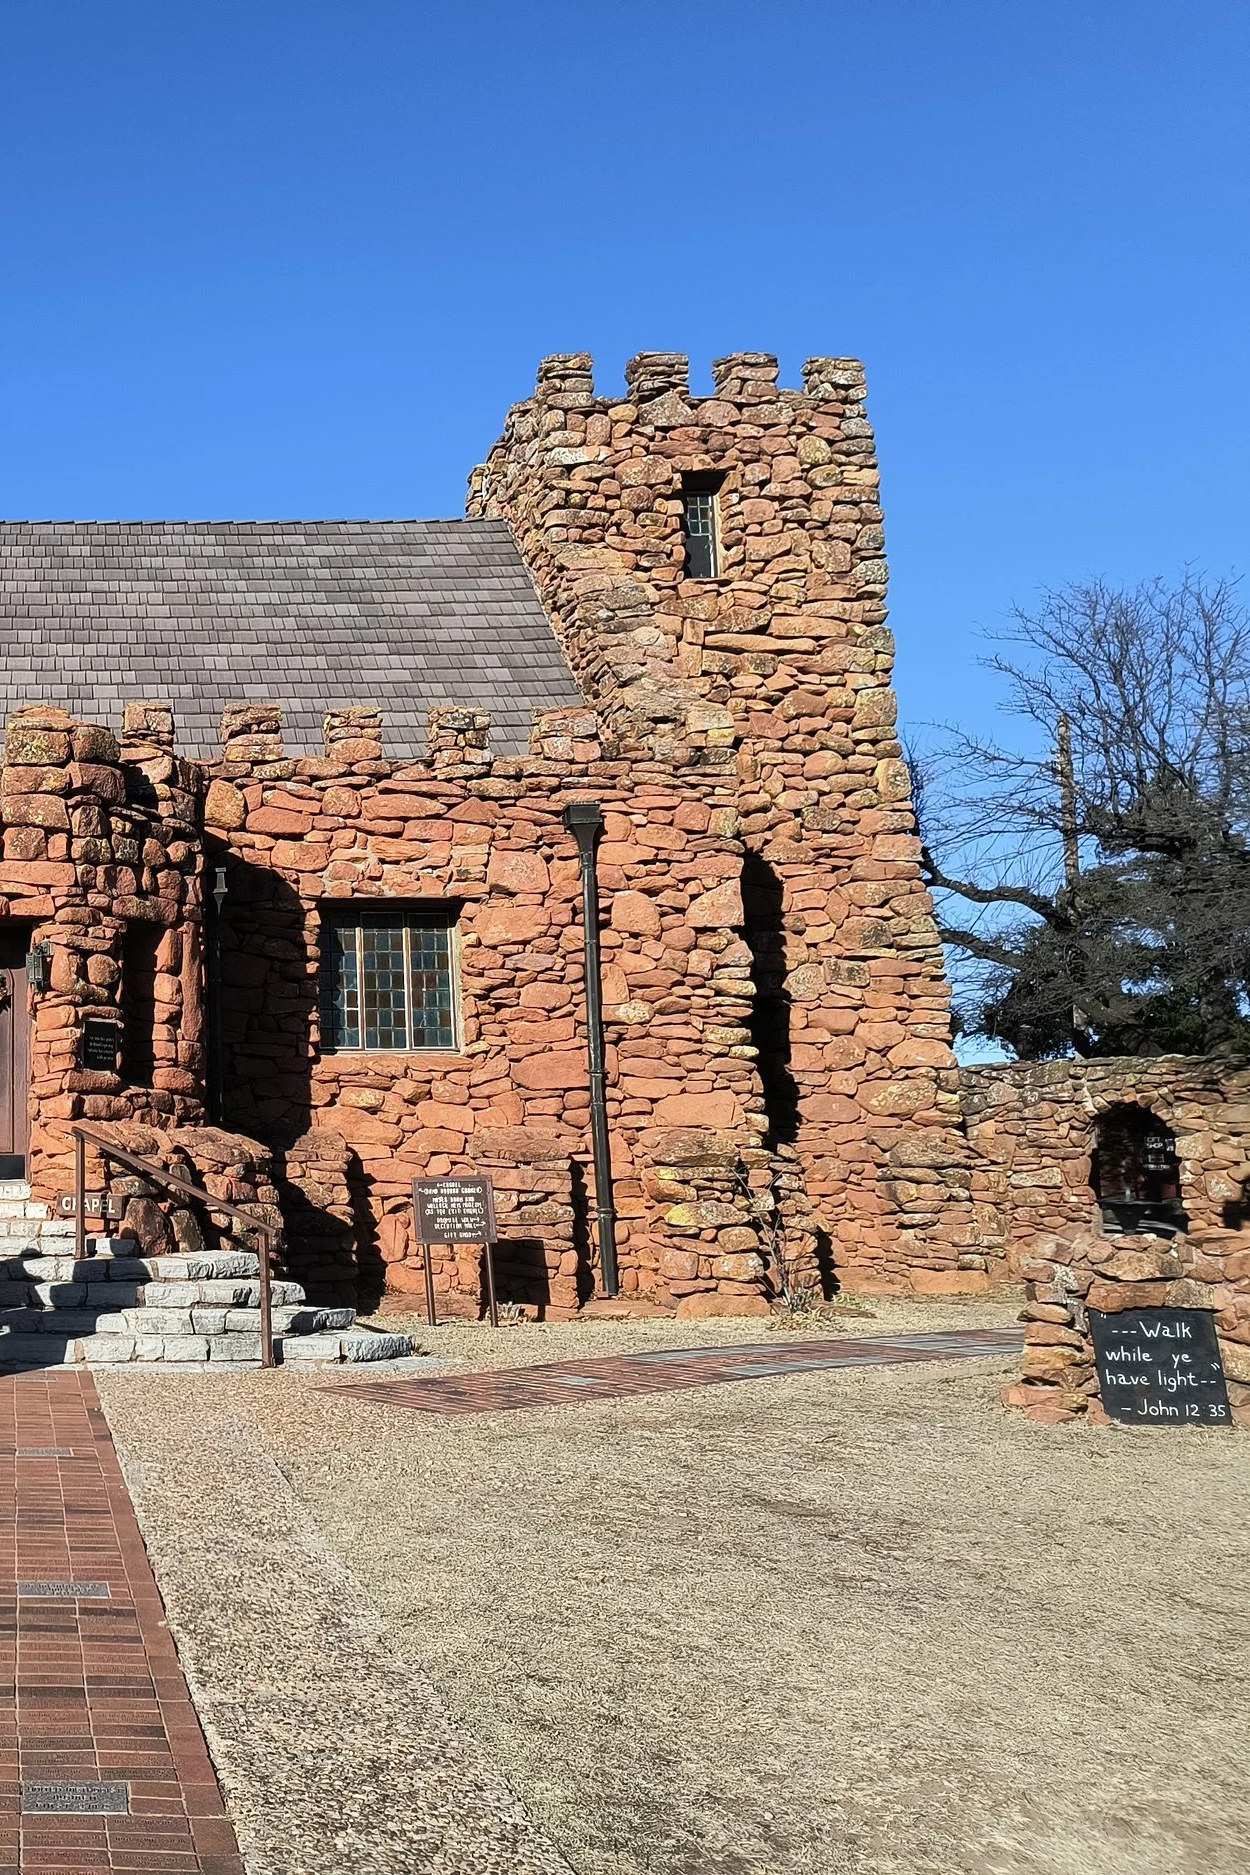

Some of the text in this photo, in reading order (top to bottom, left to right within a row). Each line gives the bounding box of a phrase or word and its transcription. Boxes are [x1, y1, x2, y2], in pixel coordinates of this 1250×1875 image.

[1105, 1344, 1192, 1370] while ye
[1105, 1368, 1151, 1387] have
[1137, 1398, 1179, 1417] John
